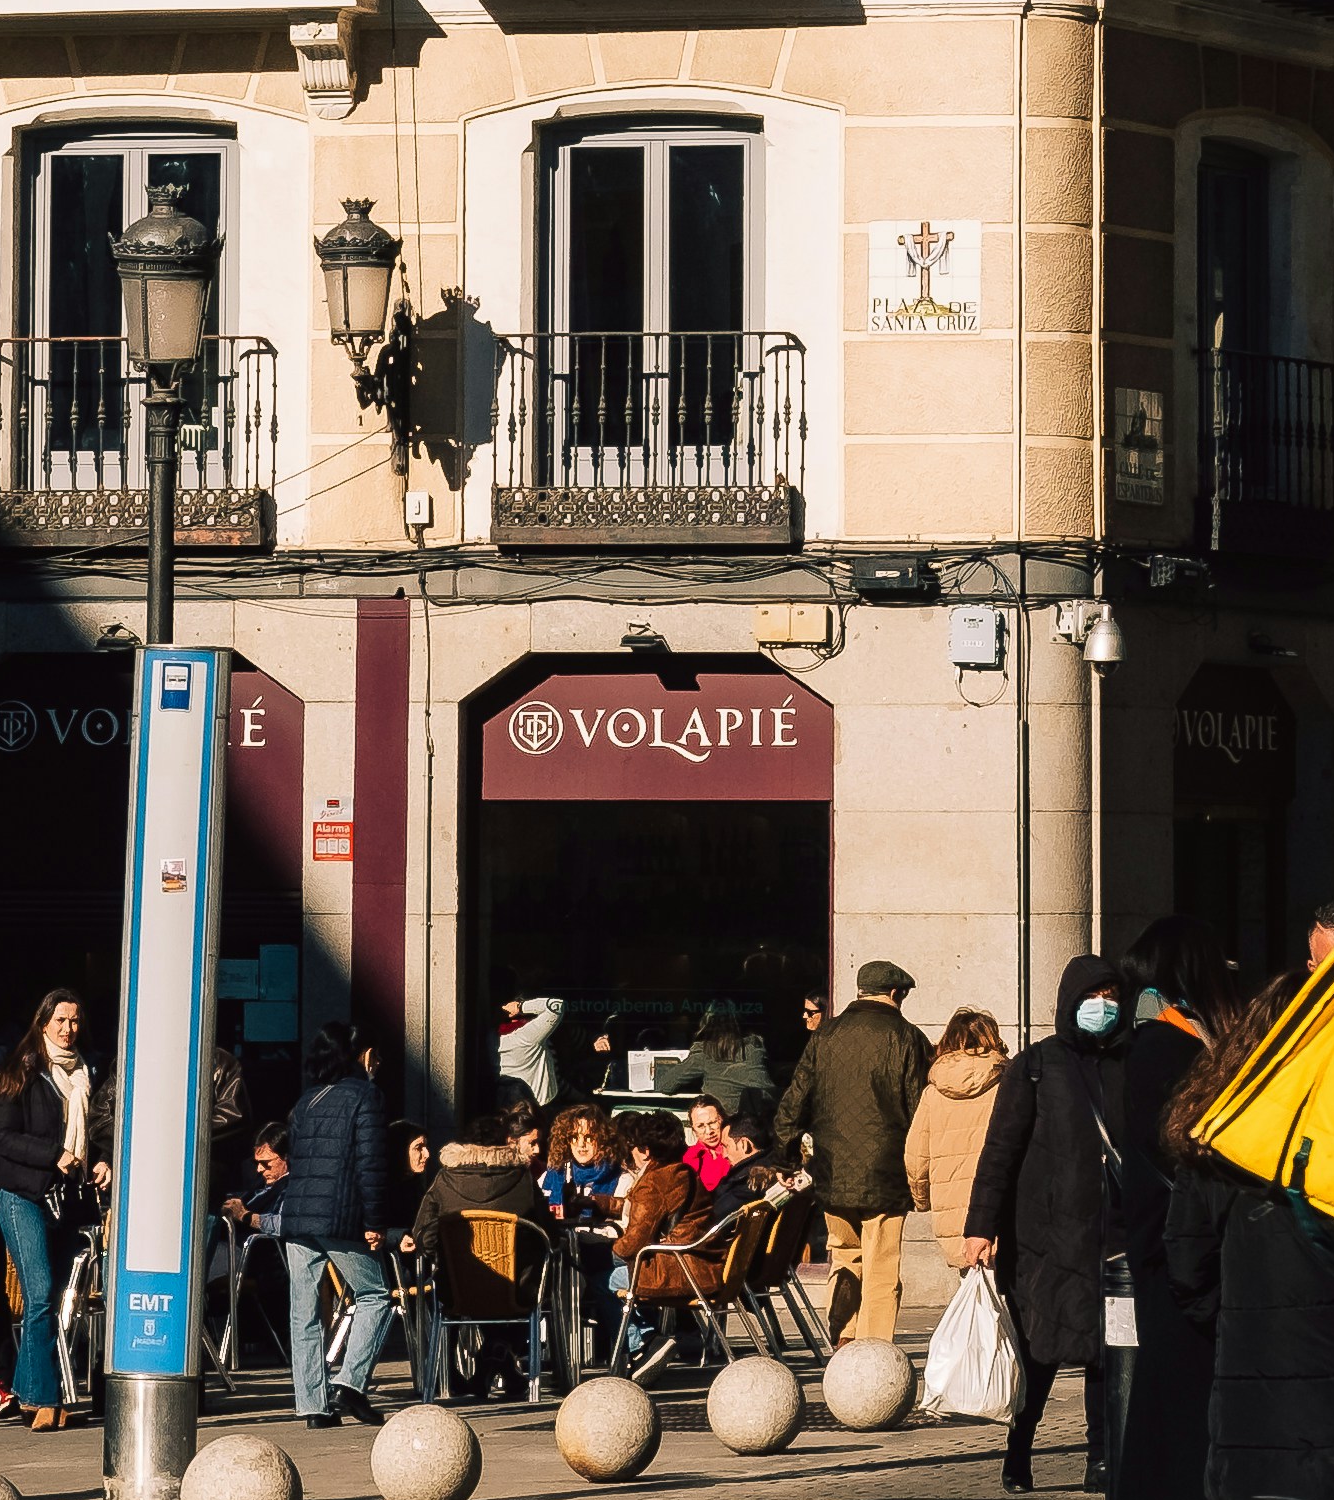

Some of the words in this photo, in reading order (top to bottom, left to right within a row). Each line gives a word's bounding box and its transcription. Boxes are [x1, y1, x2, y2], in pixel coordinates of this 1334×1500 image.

[872, 297, 937, 314] PLAZA
[948, 301, 977, 314] DE
[871, 315, 927, 331] SANTA
[936, 315, 978, 331] CRUZ
[568, 694, 798, 763] VOLAPIÉ
[1181, 704, 1278, 764] VOLAPIÉ
[316, 823, 351, 833] Alarma
[128, 1293, 174, 1312] EMT
